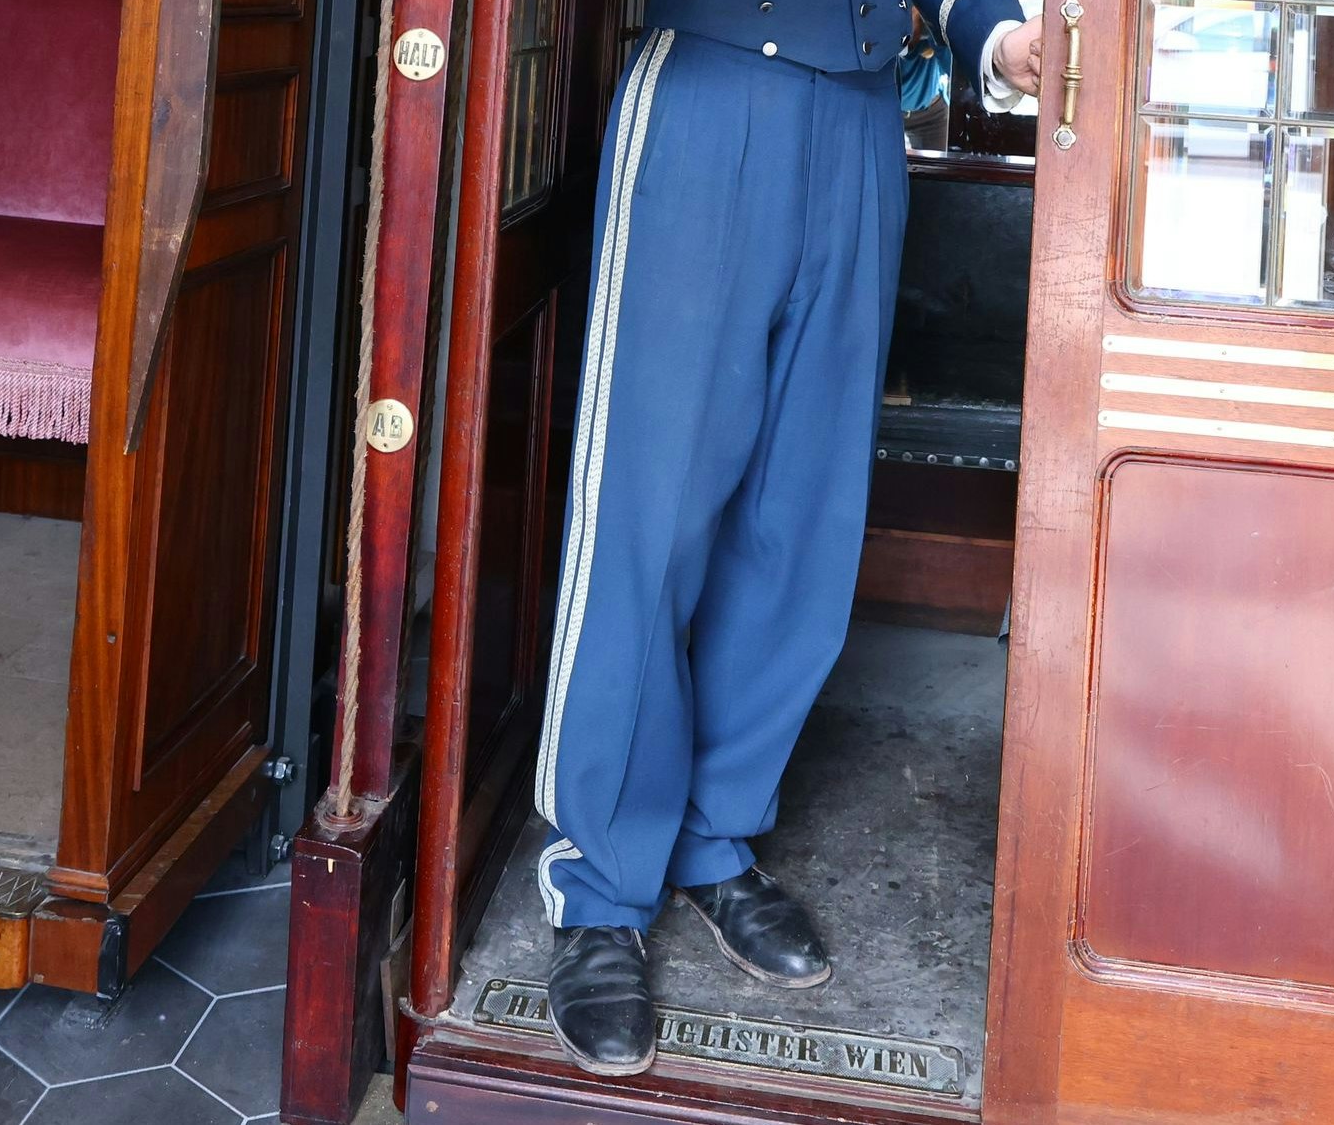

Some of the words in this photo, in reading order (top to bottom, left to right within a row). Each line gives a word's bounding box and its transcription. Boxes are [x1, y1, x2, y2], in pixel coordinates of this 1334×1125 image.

[398, 40, 442, 69] HALT
[372, 413, 403, 438] AB
[655, 1013, 821, 1063] ÜGLISTER
[844, 1043, 928, 1078] WIEN
